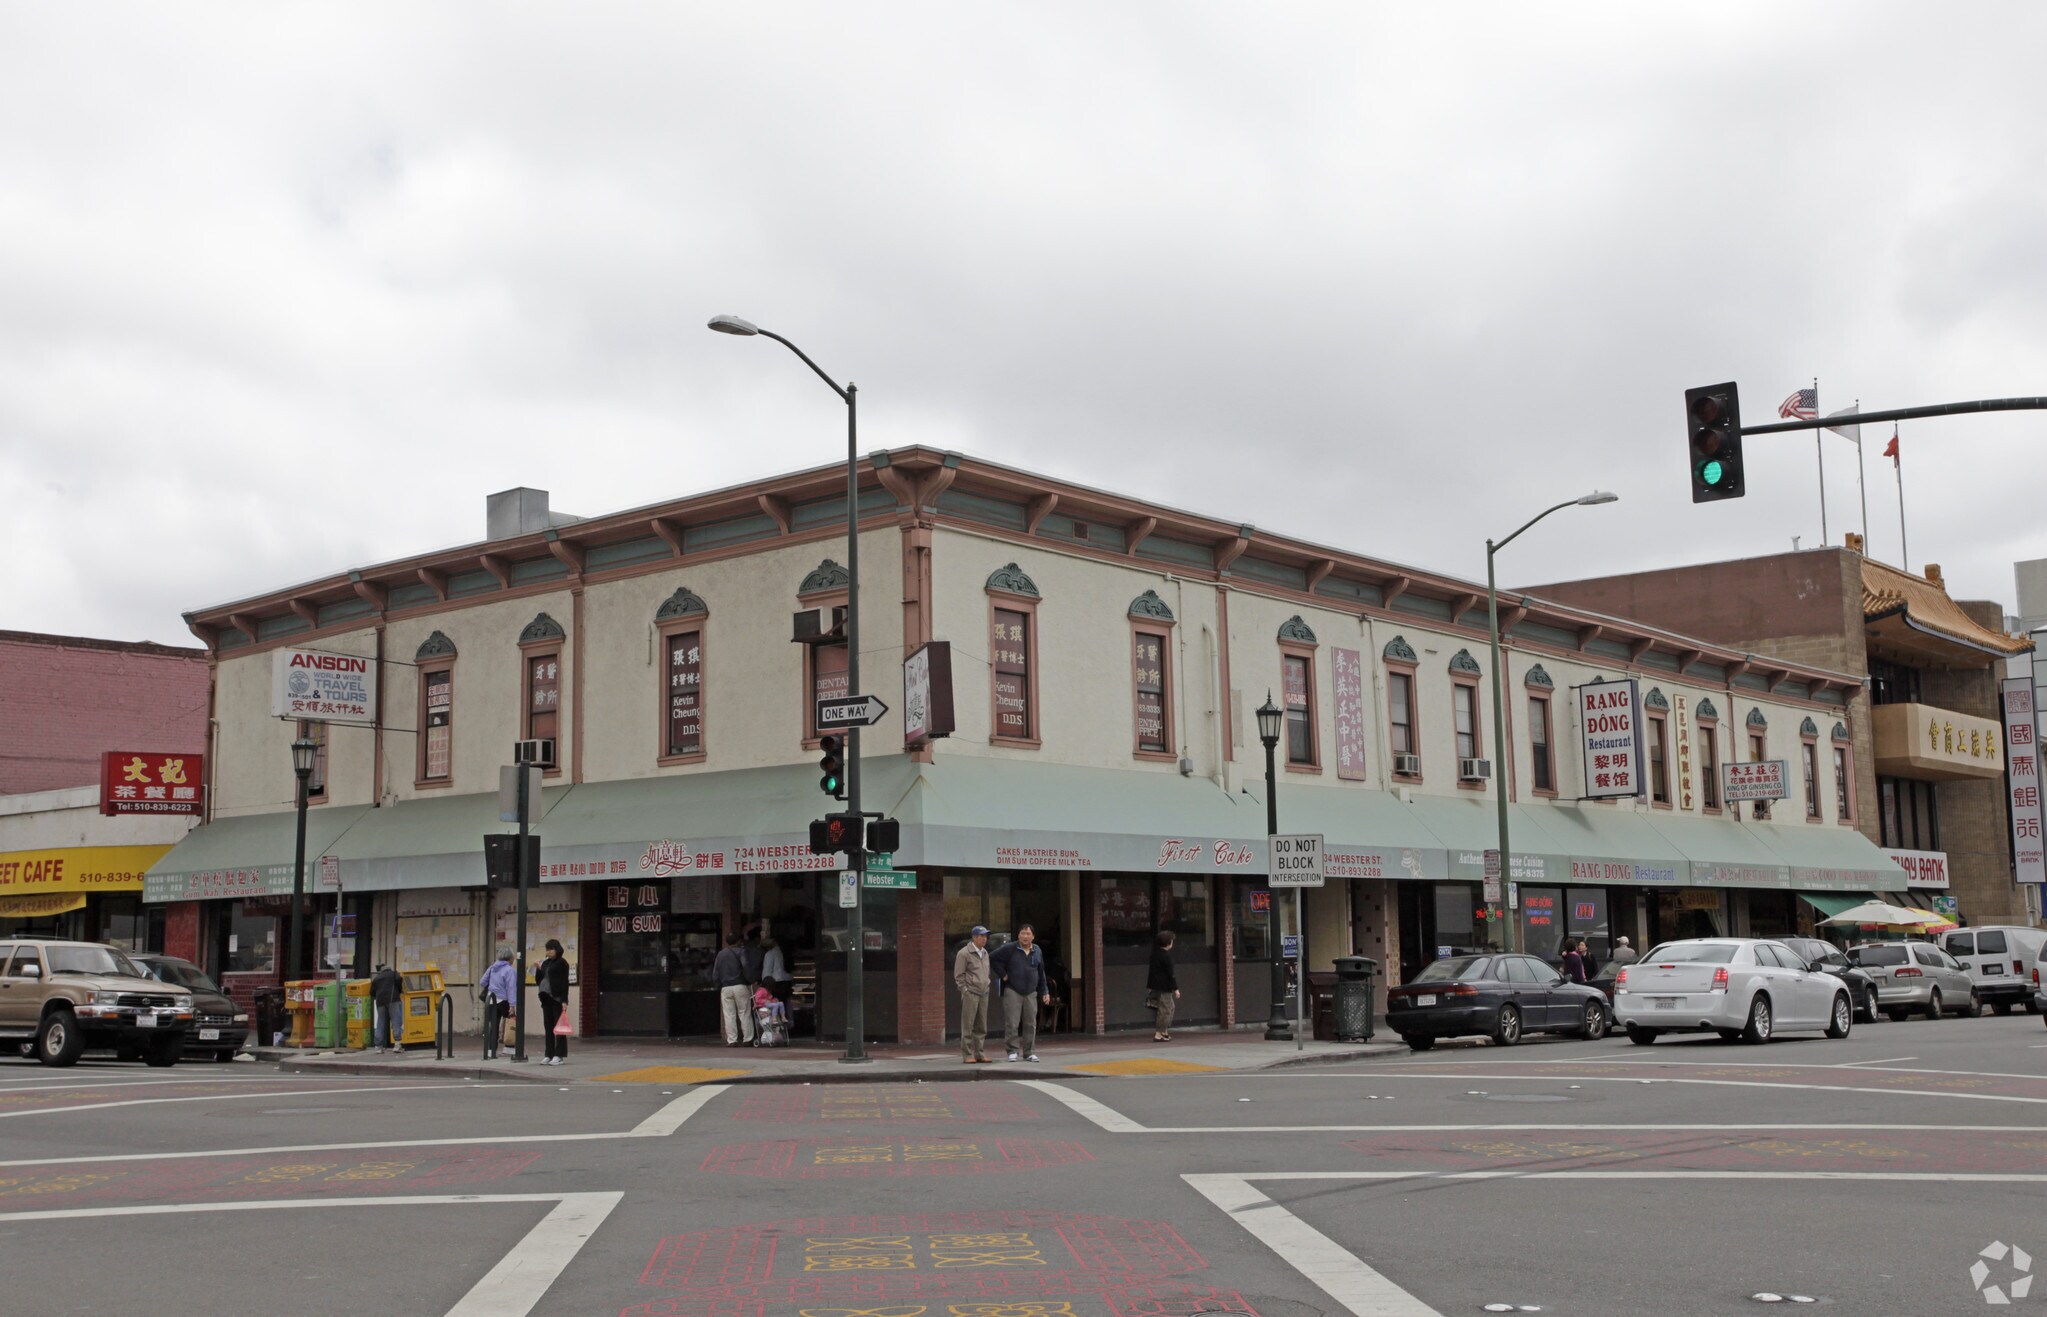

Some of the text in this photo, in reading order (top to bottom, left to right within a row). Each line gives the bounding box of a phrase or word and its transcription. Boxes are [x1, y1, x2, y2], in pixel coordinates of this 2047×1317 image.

[290, 653, 366, 673] ANSON
[313, 671, 341, 680] WORLD
[314, 679, 365, 692] TRAVEL
[312, 690, 321, 699] &
[324, 690, 367, 703] TOURS
[673, 695, 694, 707] Kevin
[291, 700, 365, 715] 安順旅行社
[825, 705, 867, 720] ONE WAY
[1137, 703, 1160, 714] 63-3333
[1003, 713, 1024, 725] D.D.S.
[1138, 718, 1162, 730] ENTAL
[1587, 713, 1629, 734] ĐÔNG
[1138, 727, 1158, 738] FFICE
[1589, 735, 1631, 750] Restaurant
[1594, 753, 1628, 769] 黎明
[123, 757, 187, 784] 文記
[2010, 724, 2039, 838] 國泰銀行
[114, 785, 195, 799] 茶餐廳
[117, 803, 192, 811] Tel: 510-839-6223
[734, 845, 812, 859] 734 WEBSTER
[1276, 839, 1316, 852] DO NOT
[996, 848, 1079, 858] CAKES PASTRIES BUNS
[1157, 839, 1254, 868] First Cake
[1323, 853, 1332, 862] 34
[1334, 854, 1370, 864] WEBSTER
[695, 852, 724, 874] 餅屋
[1011, 857, 1027, 865] SUM
[1029, 857, 1056, 866] COFFEE
[1058, 858, 1076, 866] MILK
[1278, 857, 1314, 869] BLOCK
[1458, 853, 1484, 864] Authent
[1523, 856, 1544, 867] Cuisine
[23, 859, 64, 883] CAFE
[1325, 865, 1381, 877] L:510-893-2288
[1510, 869, 1545, 878] 35-8375
[1635, 865, 1675, 880] Restaurant
[1919, 858, 1945, 881] BANK
[867, 873, 895, 885] Webster
[1272, 873, 1321, 882] INTERSECTION
[182, 886, 267, 899] Gum Wah Restaurant
[607, 885, 658, 908] 點心
[1251, 893, 1271, 910] OPE
[605, 915, 661, 933] DIM SUM
